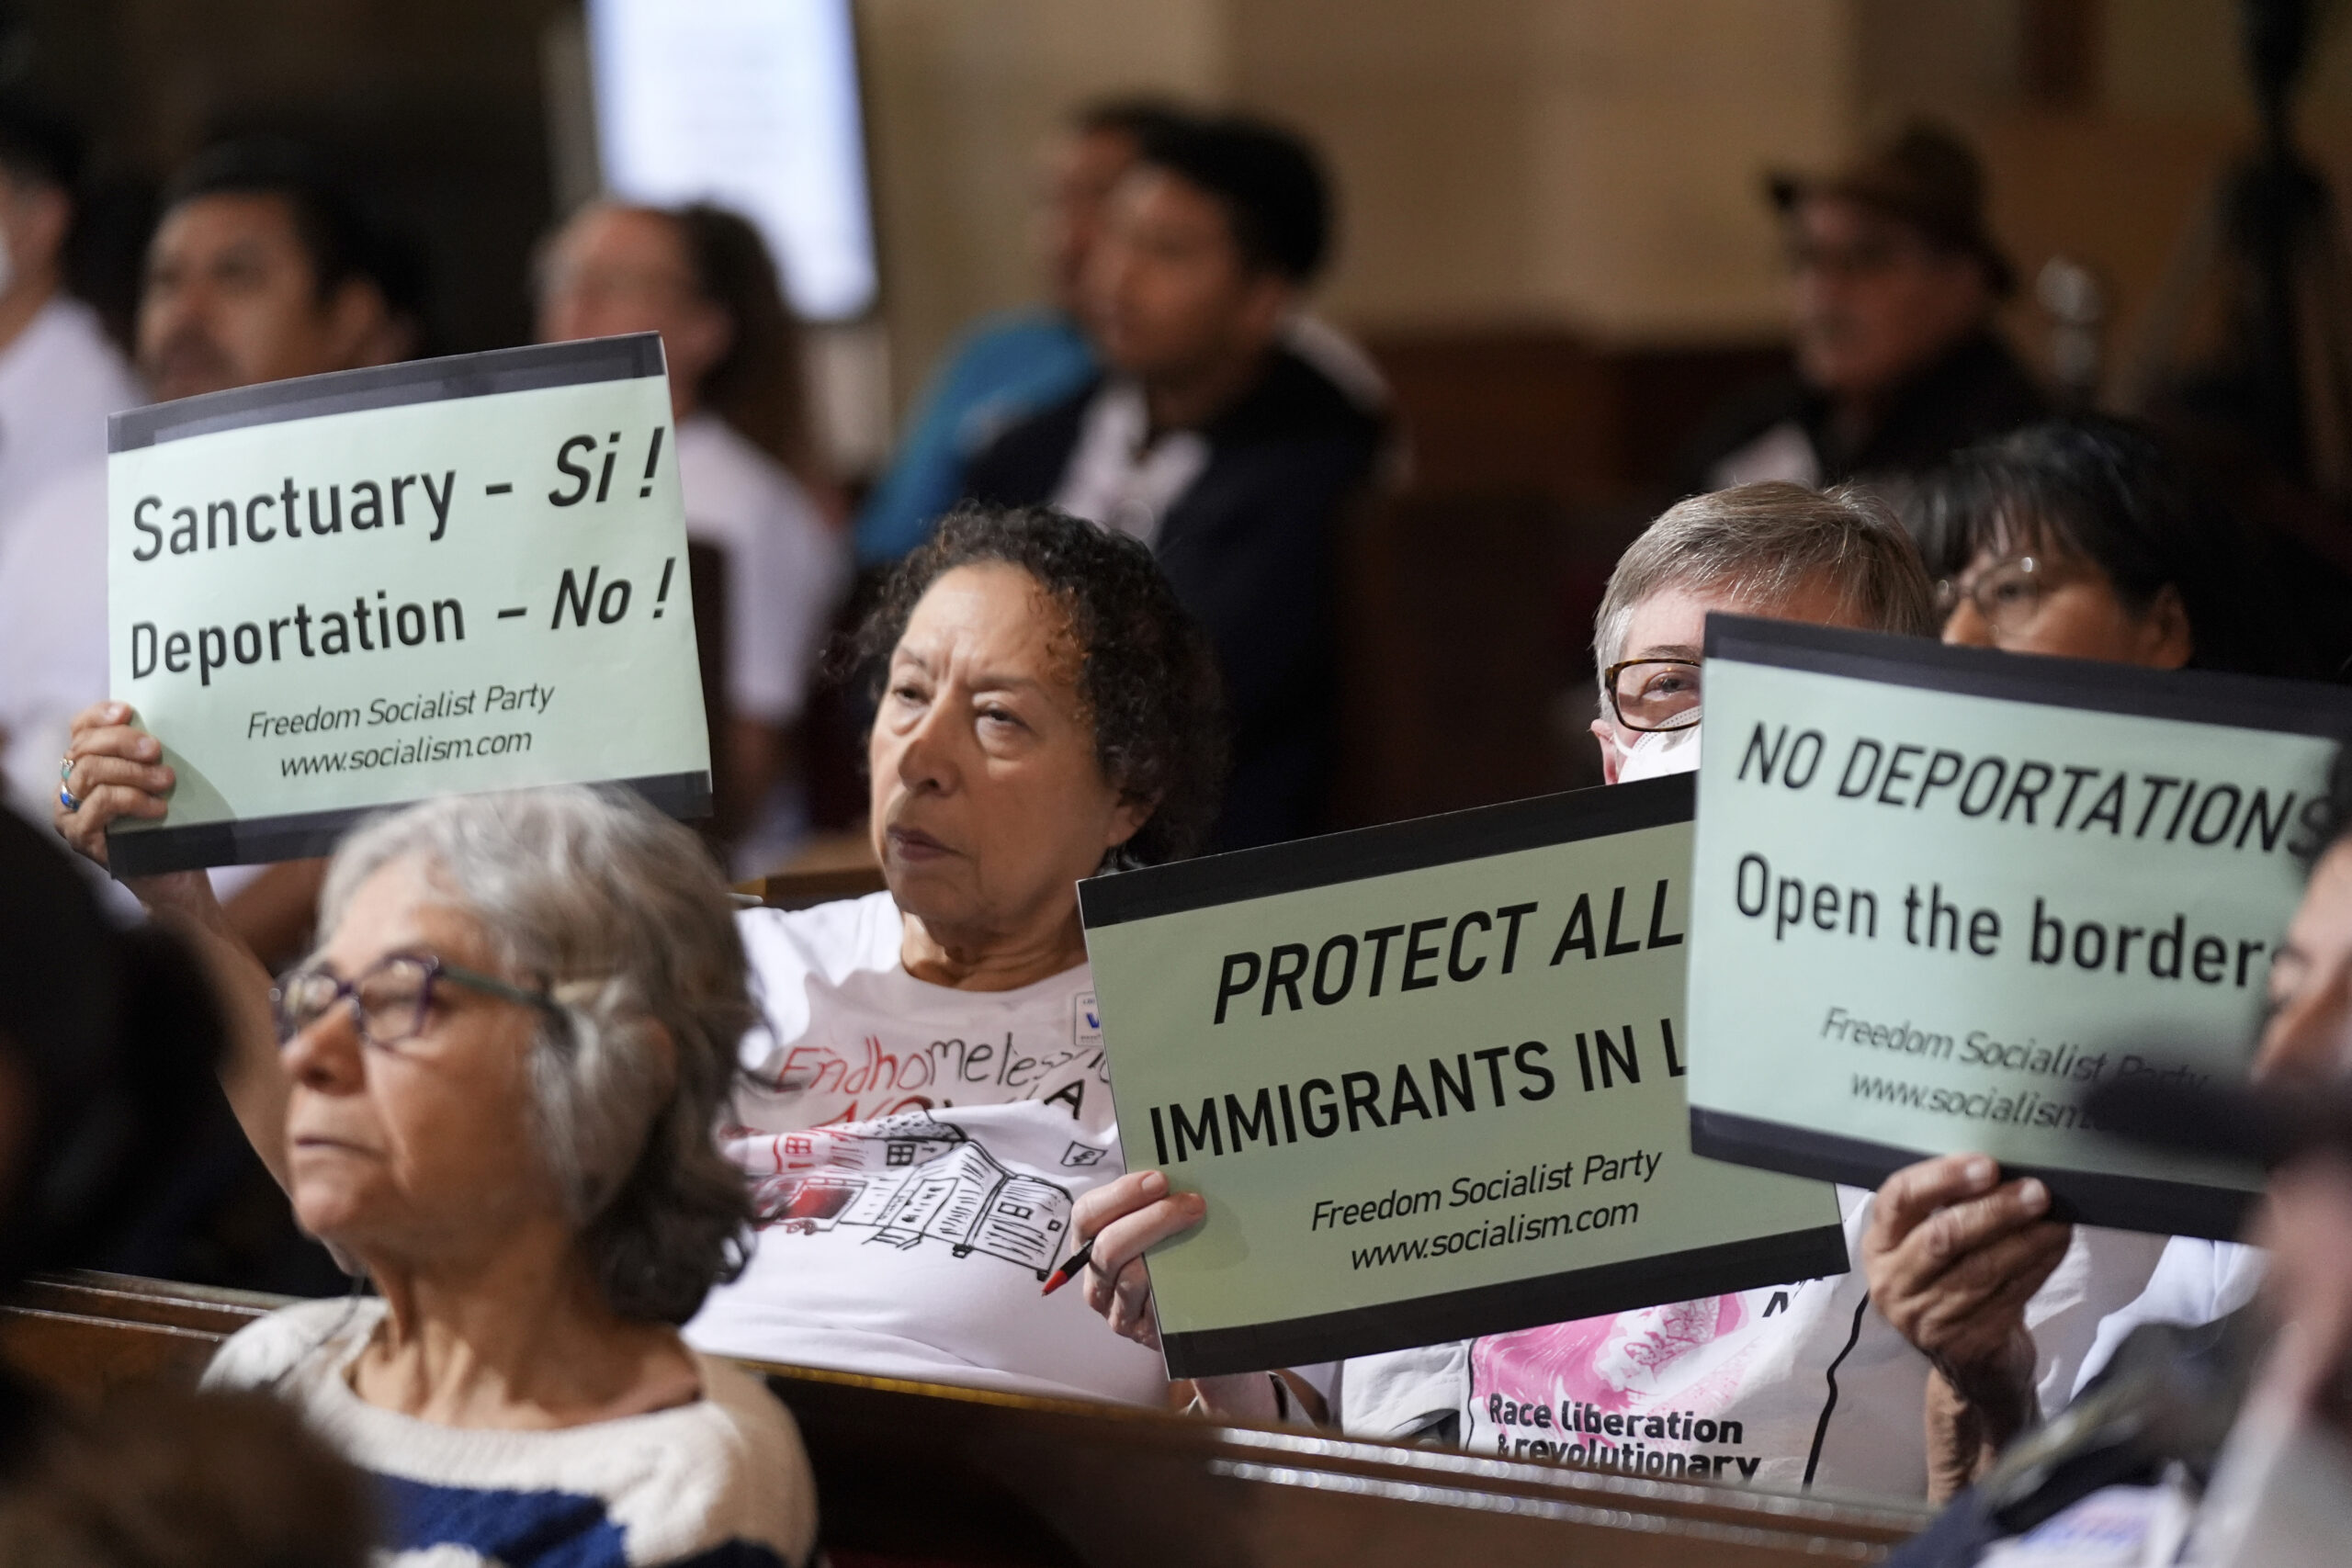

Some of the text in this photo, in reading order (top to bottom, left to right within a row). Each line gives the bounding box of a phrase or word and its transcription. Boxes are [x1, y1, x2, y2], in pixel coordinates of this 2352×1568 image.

[132, 470, 456, 562] Sanctuary
[548, 432, 621, 507] Si
[639, 426, 665, 498] !
[131, 590, 466, 687] Deportation
[550, 565, 632, 630] No
[652, 557, 676, 619] !
[248, 682, 554, 739] Freedom Socialist Party
[281, 732, 532, 777] www.socialism.com
[1736, 721, 1826, 791] NO
[1213, 878, 1685, 1025] PROTECT ALL
[1736, 852, 2280, 988] Open the border
[1820, 1007, 1954, 1061] Freedom
[1959, 1032, 2107, 1081] Socialist
[1149, 1039, 1555, 1166] IMMIGRANTS
[1575, 1024, 1641, 1093] IN
[1312, 1148, 1662, 1232] Freedom Socialist Party
[1351, 1201, 1640, 1270] www.socialism.com
[1489, 1393, 1743, 1444] Race liberation
[1498, 1433, 1761, 1484] & revolutionary
